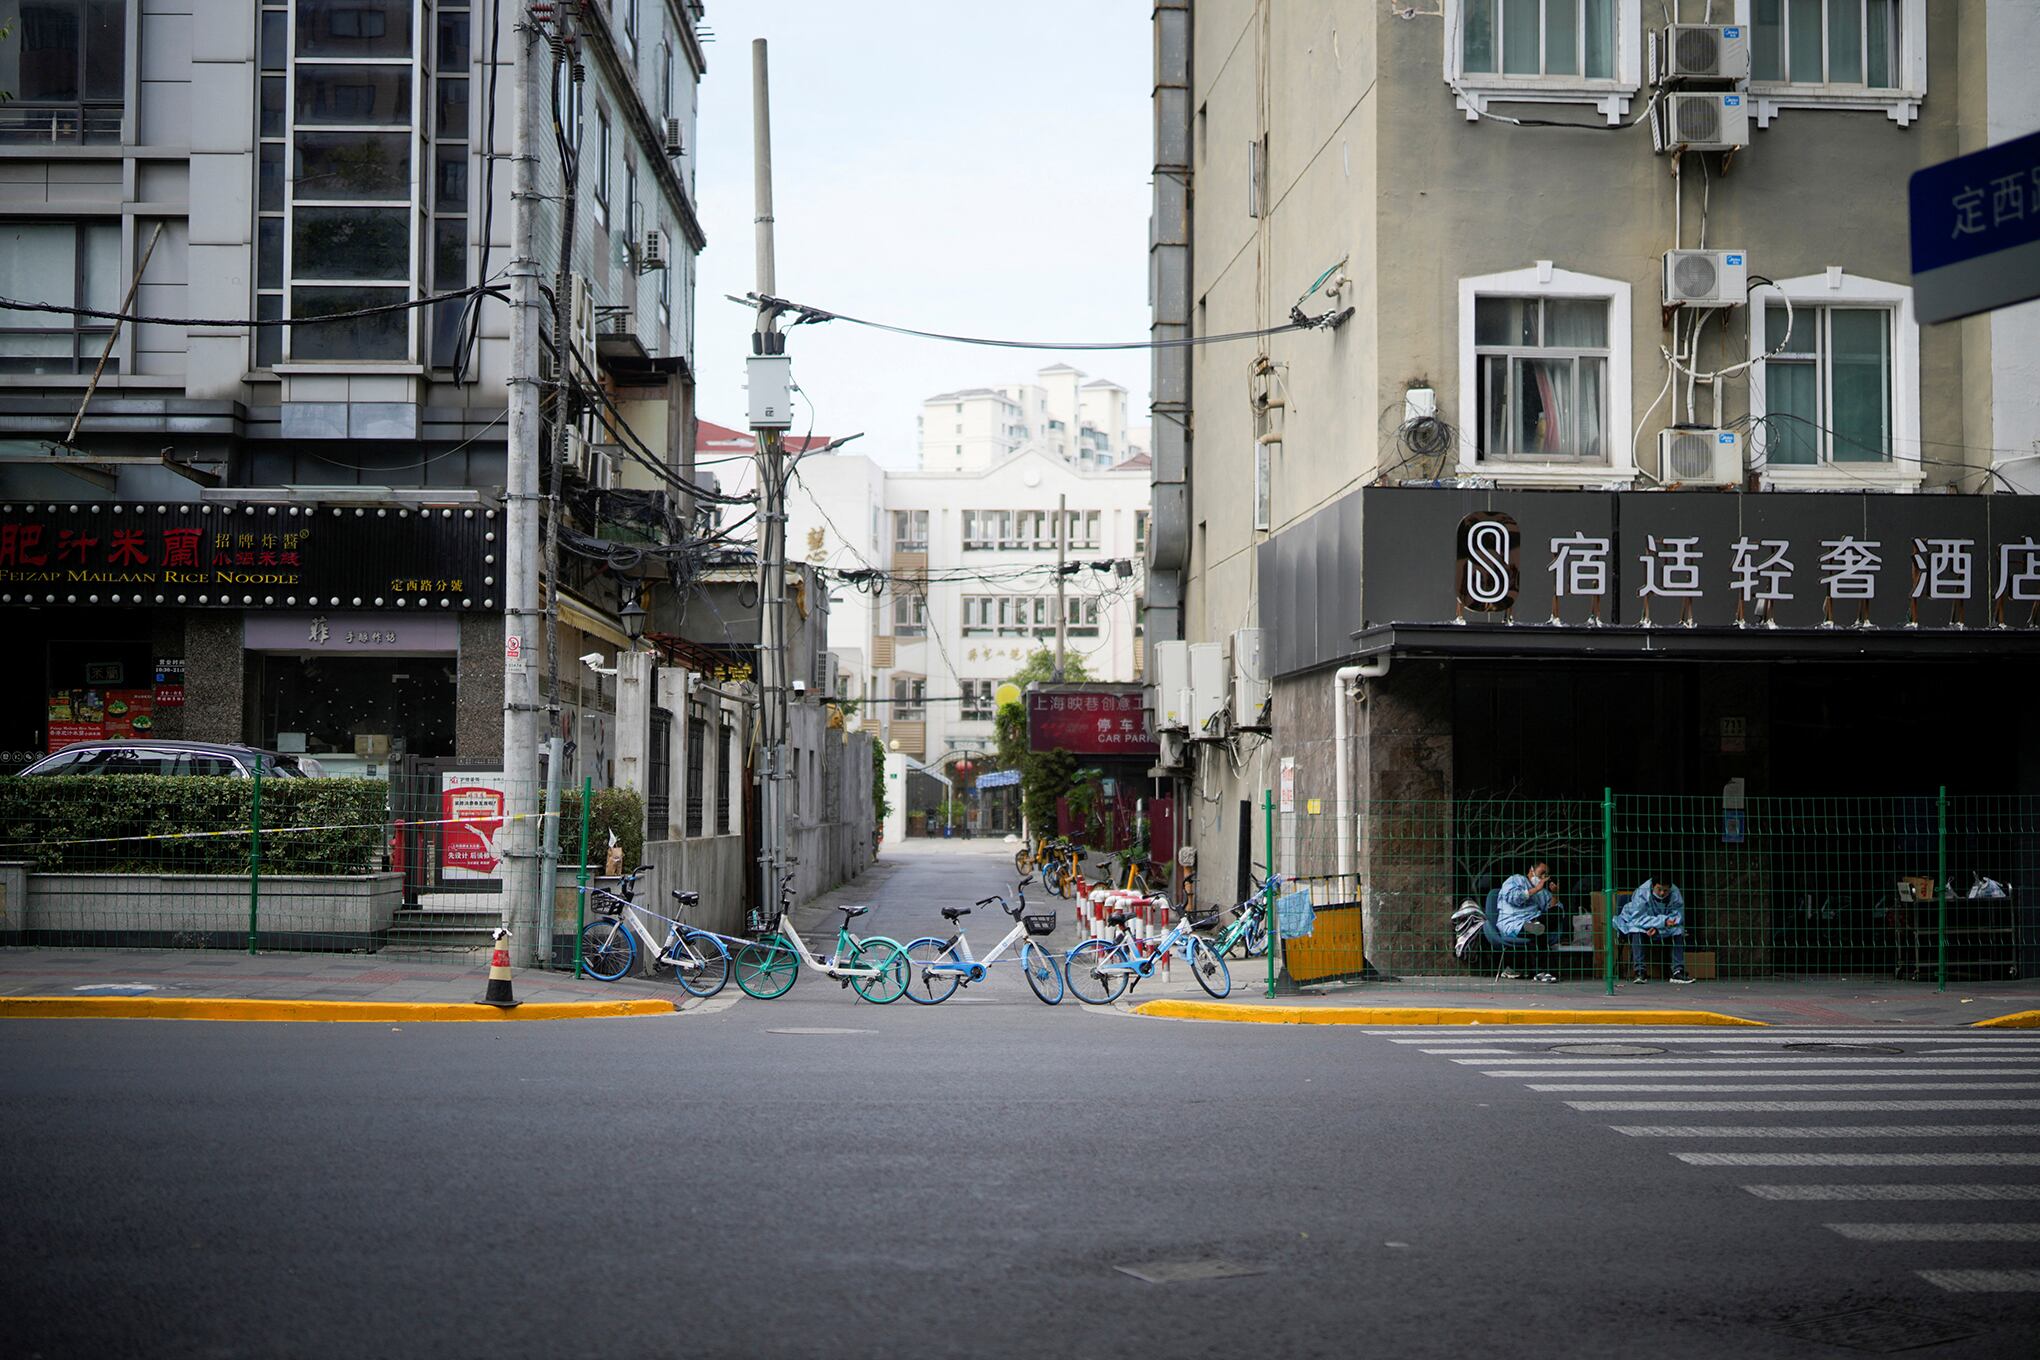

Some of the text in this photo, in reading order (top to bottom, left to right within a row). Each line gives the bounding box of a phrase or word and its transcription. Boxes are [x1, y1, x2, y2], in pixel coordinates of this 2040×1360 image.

[1548, 532, 2040, 601] 宿适轻奢酒店
[164, 571, 209, 584] RICE
[216, 571, 299, 584] NOODLE
[1097, 717, 1146, 733] 停车
[1097, 734, 1121, 743] CAR
